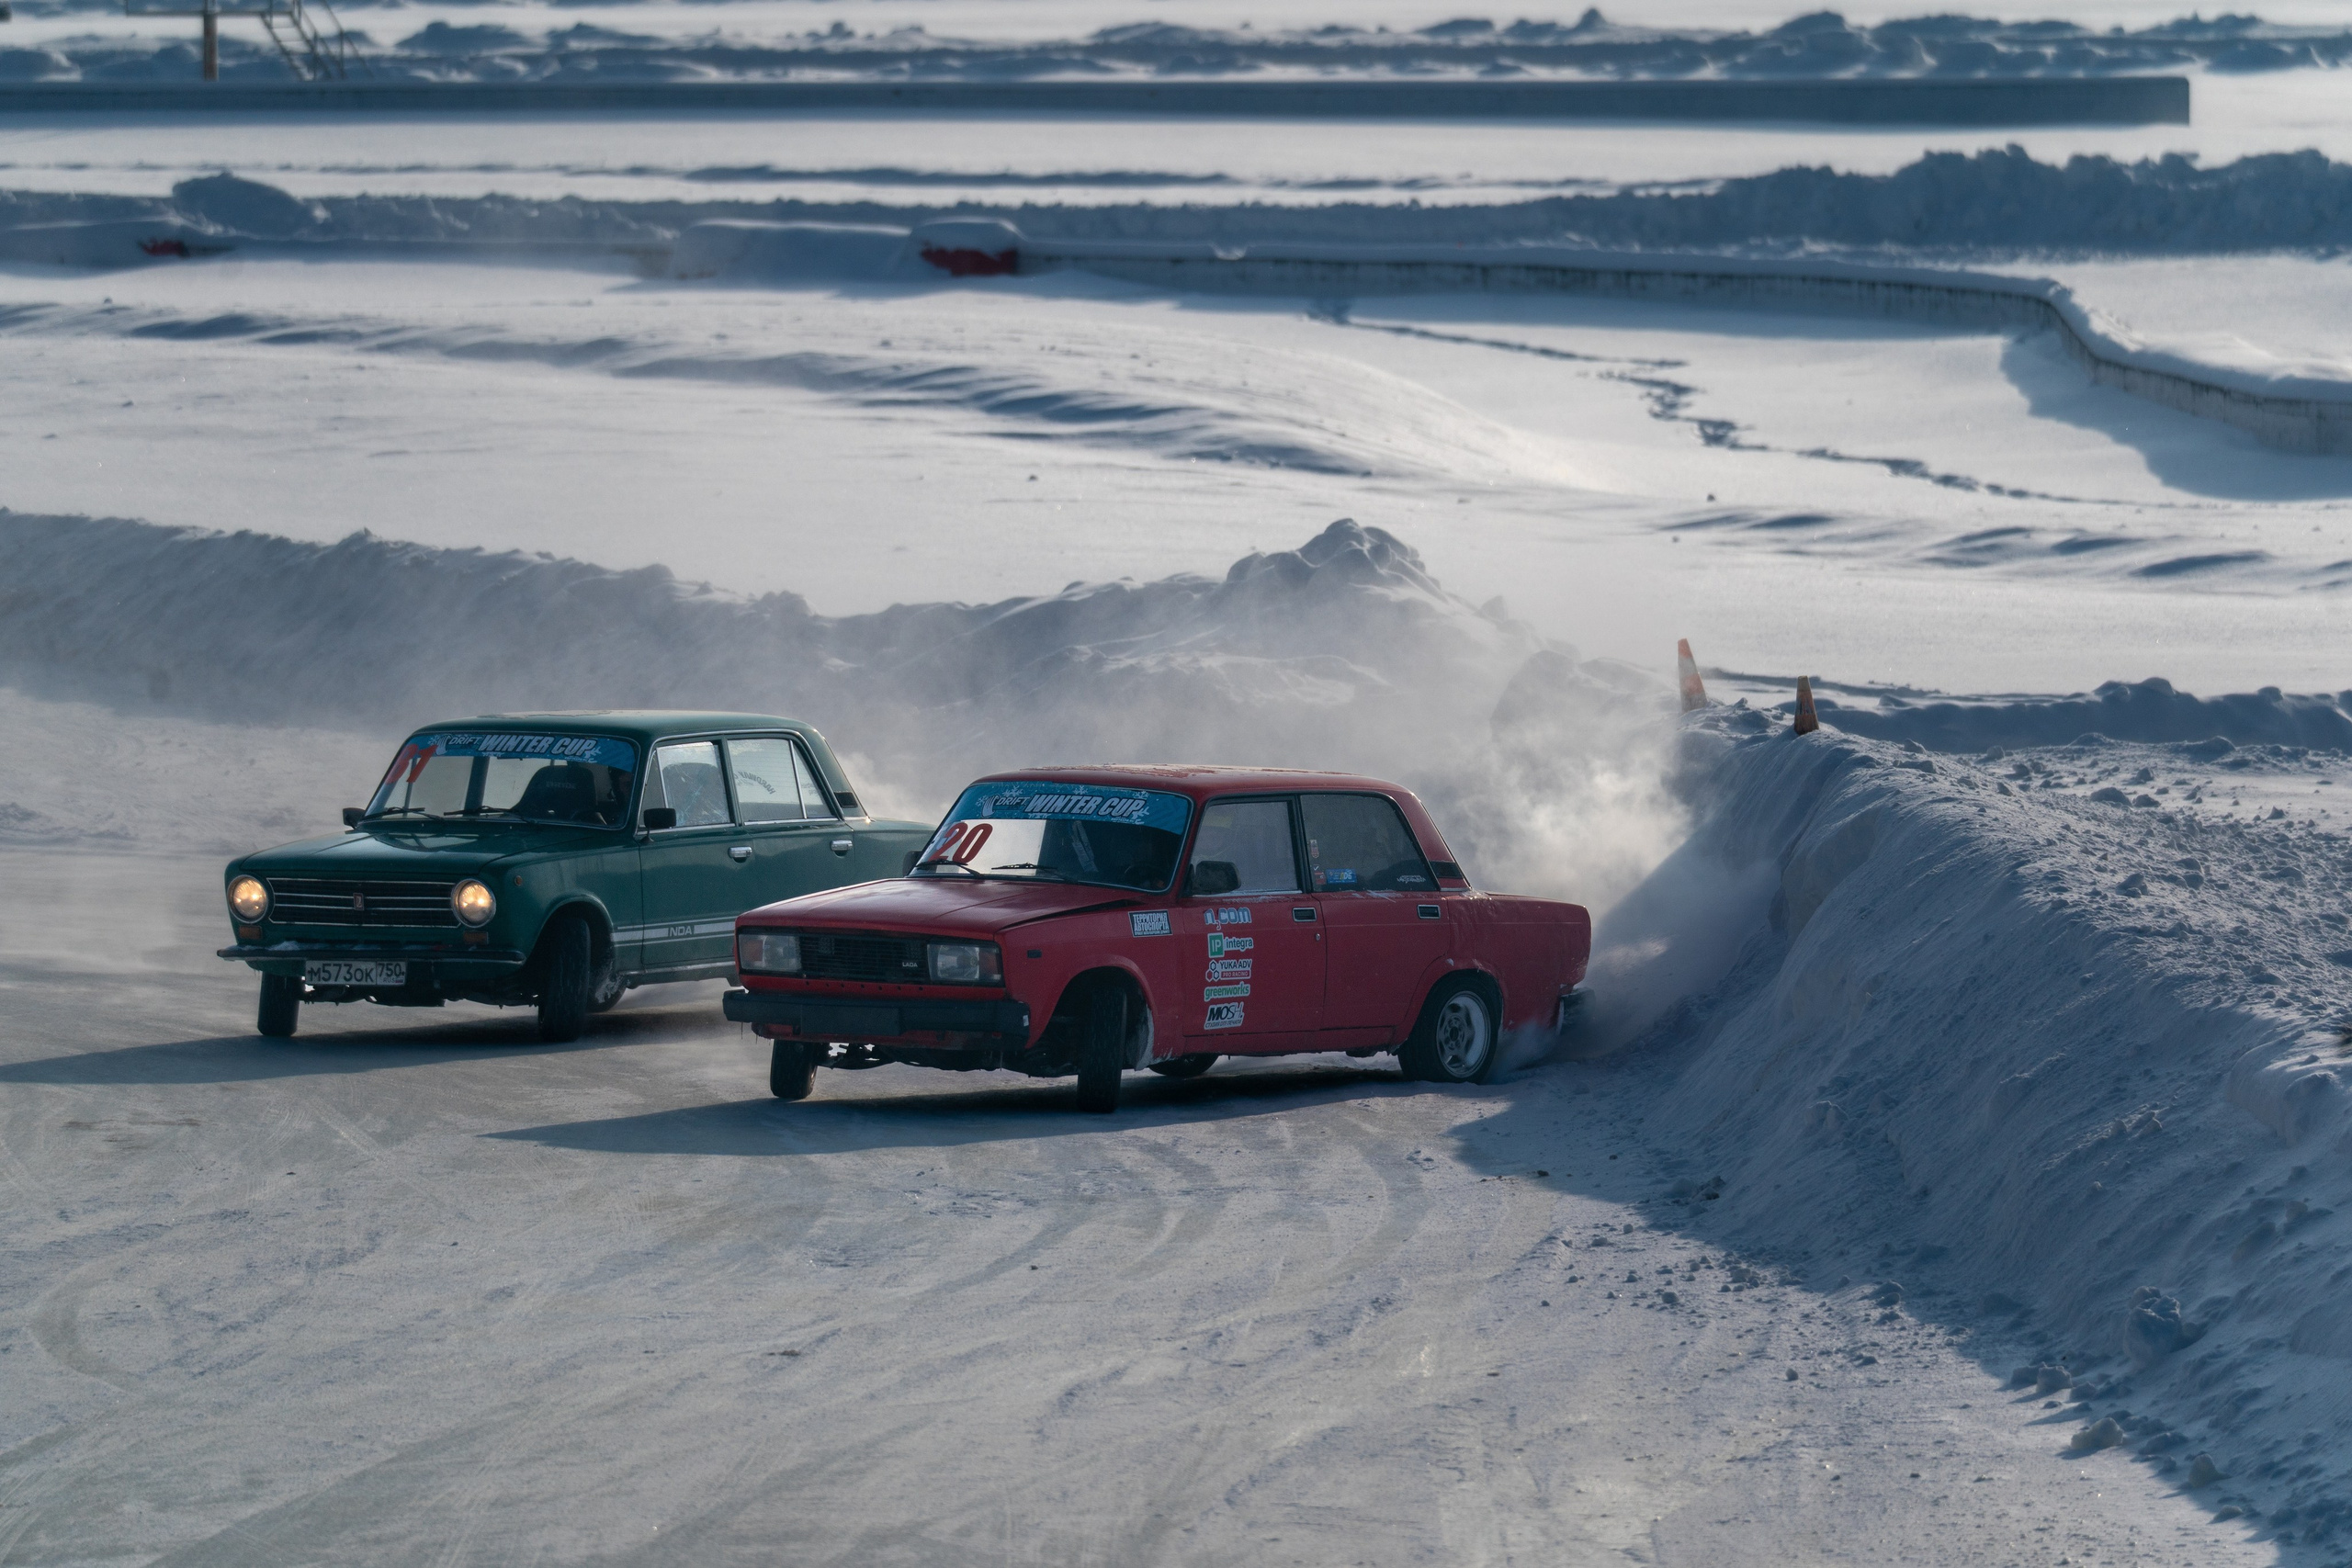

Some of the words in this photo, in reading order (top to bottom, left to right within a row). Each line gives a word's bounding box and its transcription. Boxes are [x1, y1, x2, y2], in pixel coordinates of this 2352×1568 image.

[479, 735, 553, 754] WINTER
[552, 737, 595, 758] CUP
[1024, 794, 1102, 816] WINTER
[1099, 797, 1147, 818] CUP
[928, 822, 993, 864] 20
[1133, 912, 1168, 923] ТЕРРИТОРИЯ
[669, 926, 693, 937] NDA
[1134, 920, 1170, 931] АВТОСПОРТА
[1212, 939, 1222, 952] IP
[1226, 938, 1253, 951] integra
[378, 963, 401, 977] 750
[1219, 961, 1238, 970] YUKA
[1238, 960, 1251, 969] ADV
[1205, 983, 1250, 1000] greenworks
